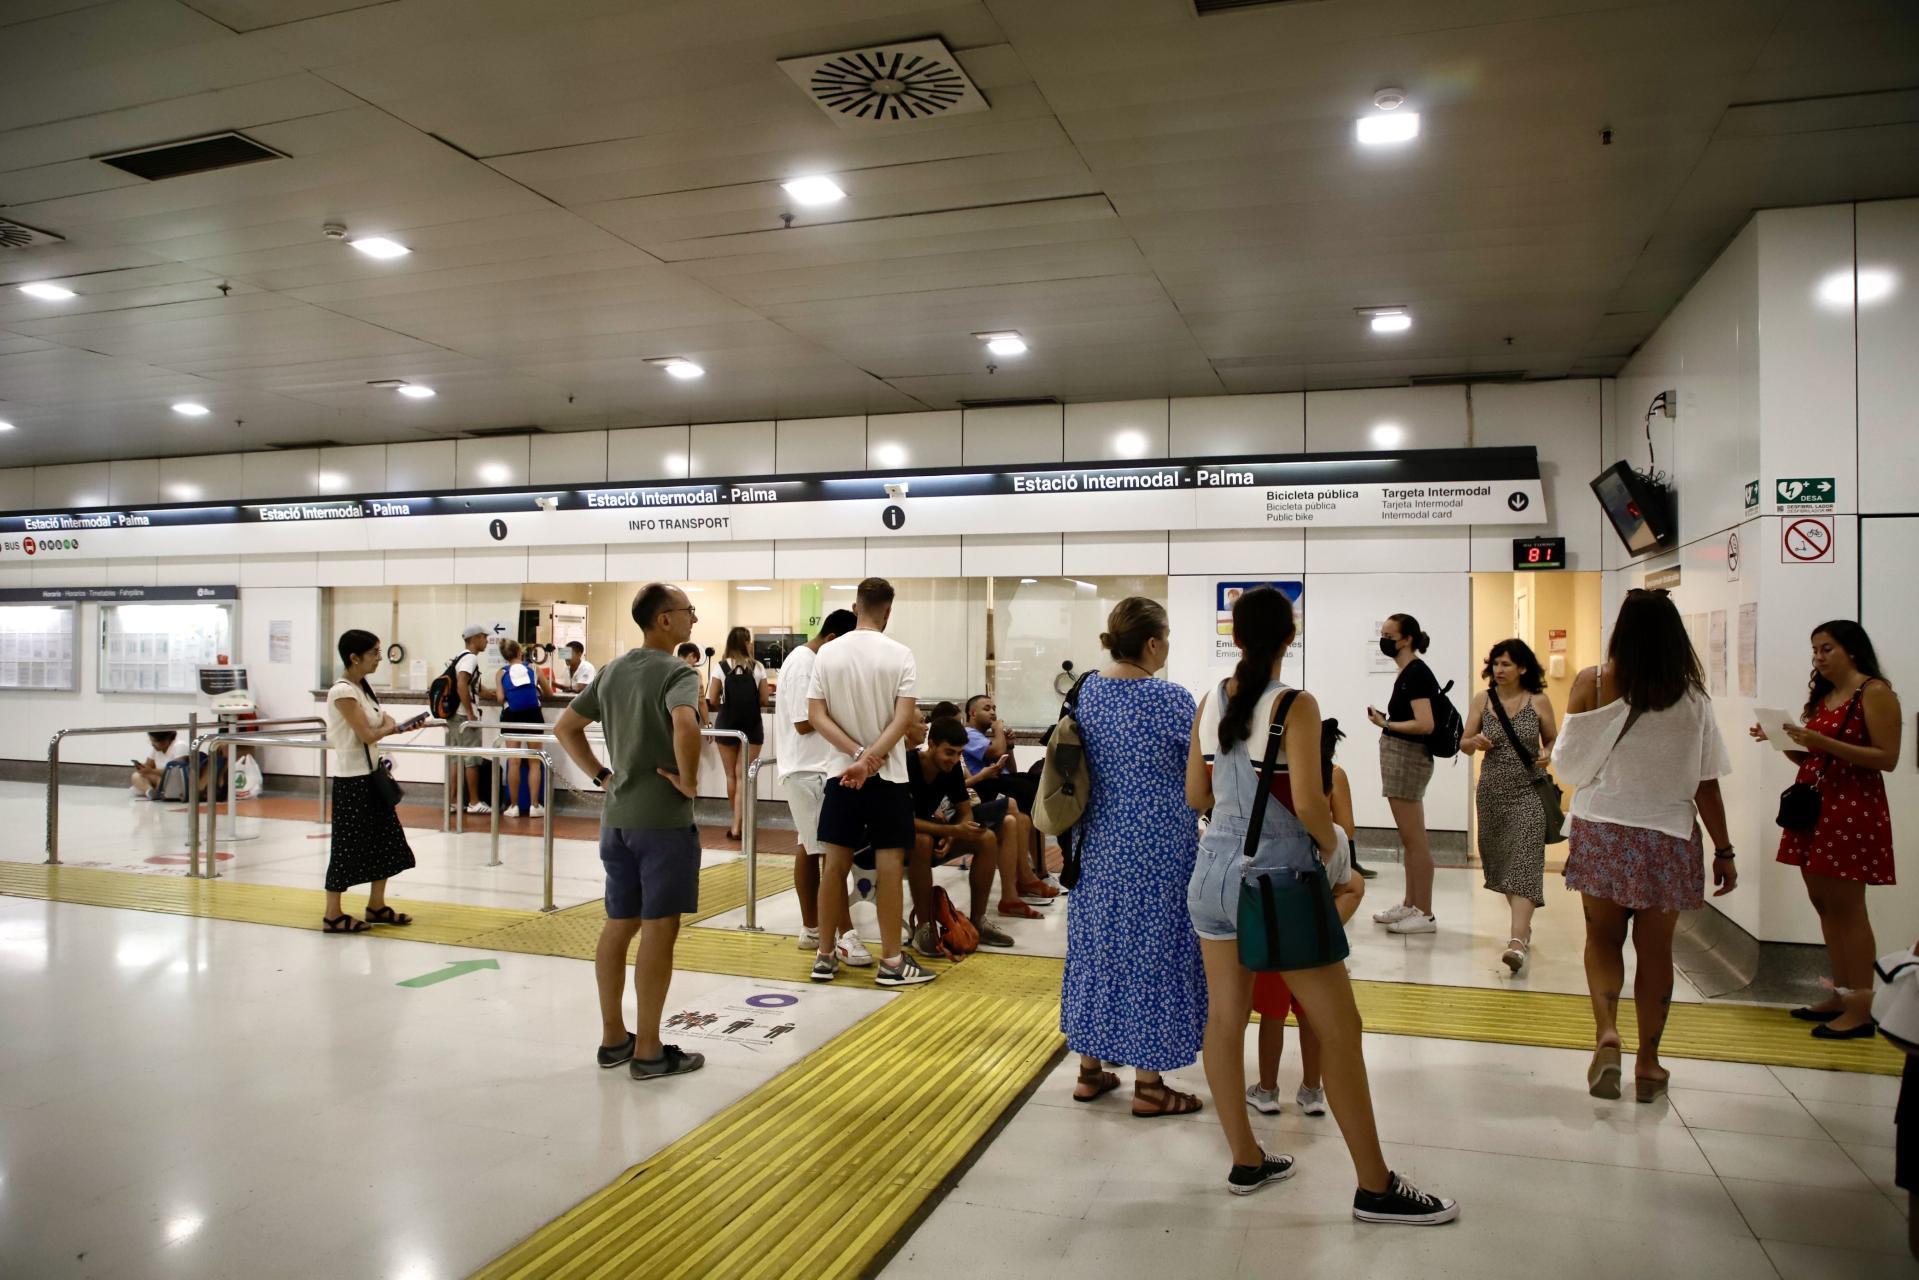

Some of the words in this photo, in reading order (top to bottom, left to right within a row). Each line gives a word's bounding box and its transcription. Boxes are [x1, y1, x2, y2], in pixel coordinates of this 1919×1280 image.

[1013, 474, 1078, 492] Estació
[1083, 471, 1179, 490] Intermodal
[1196, 469, 1255, 487] Palma
[587, 492, 639, 508] Estació
[641, 489, 718, 506] Intermodal
[731, 488, 777, 503] Palma
[1266, 490, 1314, 501] Bicicleta
[1317, 488, 1359, 502] pública
[1381, 488, 1425, 500] Targeta
[1428, 486, 1491, 497] Intermodal
[1266, 502, 1303, 511] Bicicleta
[1305, 501, 1337, 512] pública
[1381, 499, 1412, 510] Tarjeta
[1415, 498, 1464, 509] Intermodal
[259, 507, 301, 521] Estació
[302, 504, 364, 520] Intermodal
[372, 503, 410, 517] Palma
[1266, 512, 1293, 522] Public
[1295, 512, 1314, 521] bike
[1381, 510, 1430, 520] Intermodal
[1432, 509, 1453, 519] card
[24, 516, 60, 531] Estació
[60, 515, 111, 530] Intermodal
[118, 514, 150, 527] Palma
[628, 519, 656, 531] INFO
[658, 517, 730, 530] TRANSPORT
[4, 541, 20, 551] BUS
[1528, 547, 1552, 562] 81
